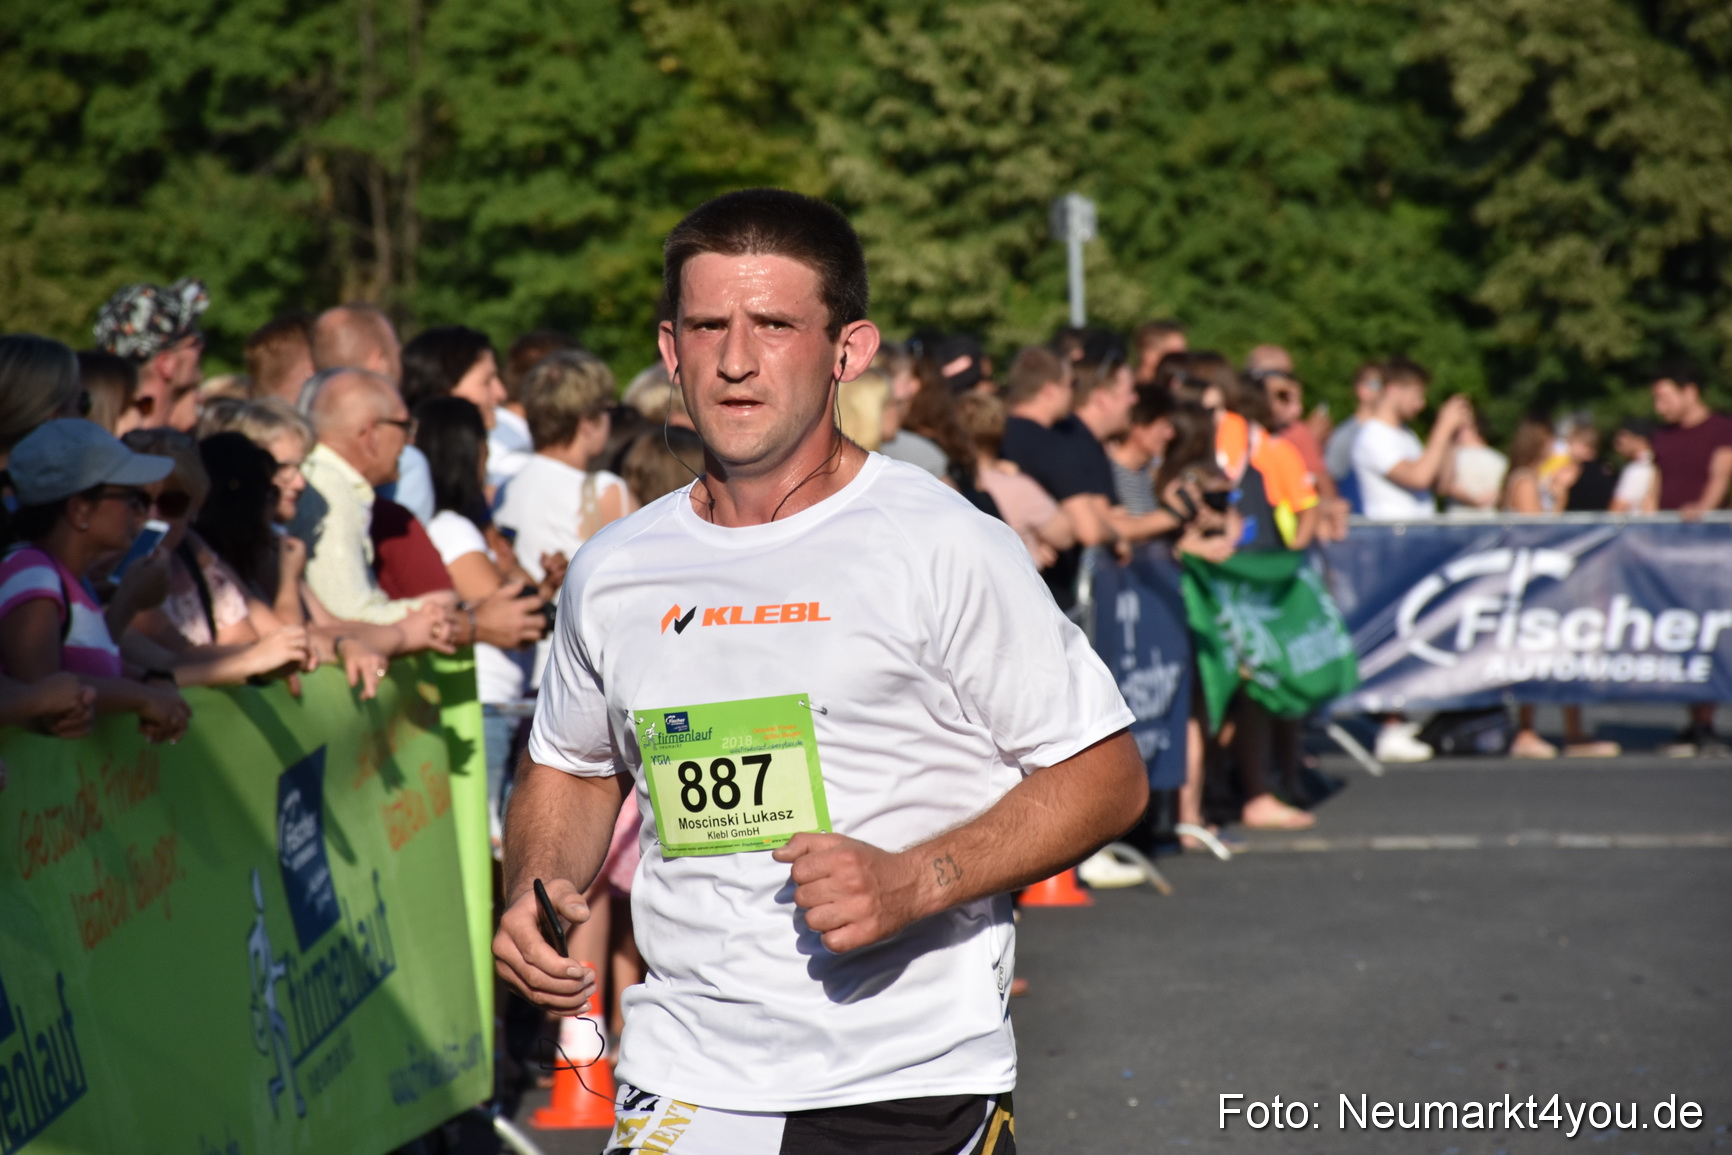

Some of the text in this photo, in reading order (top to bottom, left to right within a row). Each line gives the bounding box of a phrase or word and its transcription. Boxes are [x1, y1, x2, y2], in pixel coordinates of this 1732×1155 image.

[702, 602, 831, 626] KLEBL
[1455, 593, 1732, 652] Fischer
[1484, 653, 1713, 683] AUTOMOBILE
[658, 727, 713, 745] firmenlauf
[722, 735, 752, 749] 2018
[678, 753, 772, 813] 887
[678, 809, 794, 830] Moscinski Lukasz
[707, 827, 760, 840] Klebl GmbH
[0, 972, 88, 1155] enlauf
